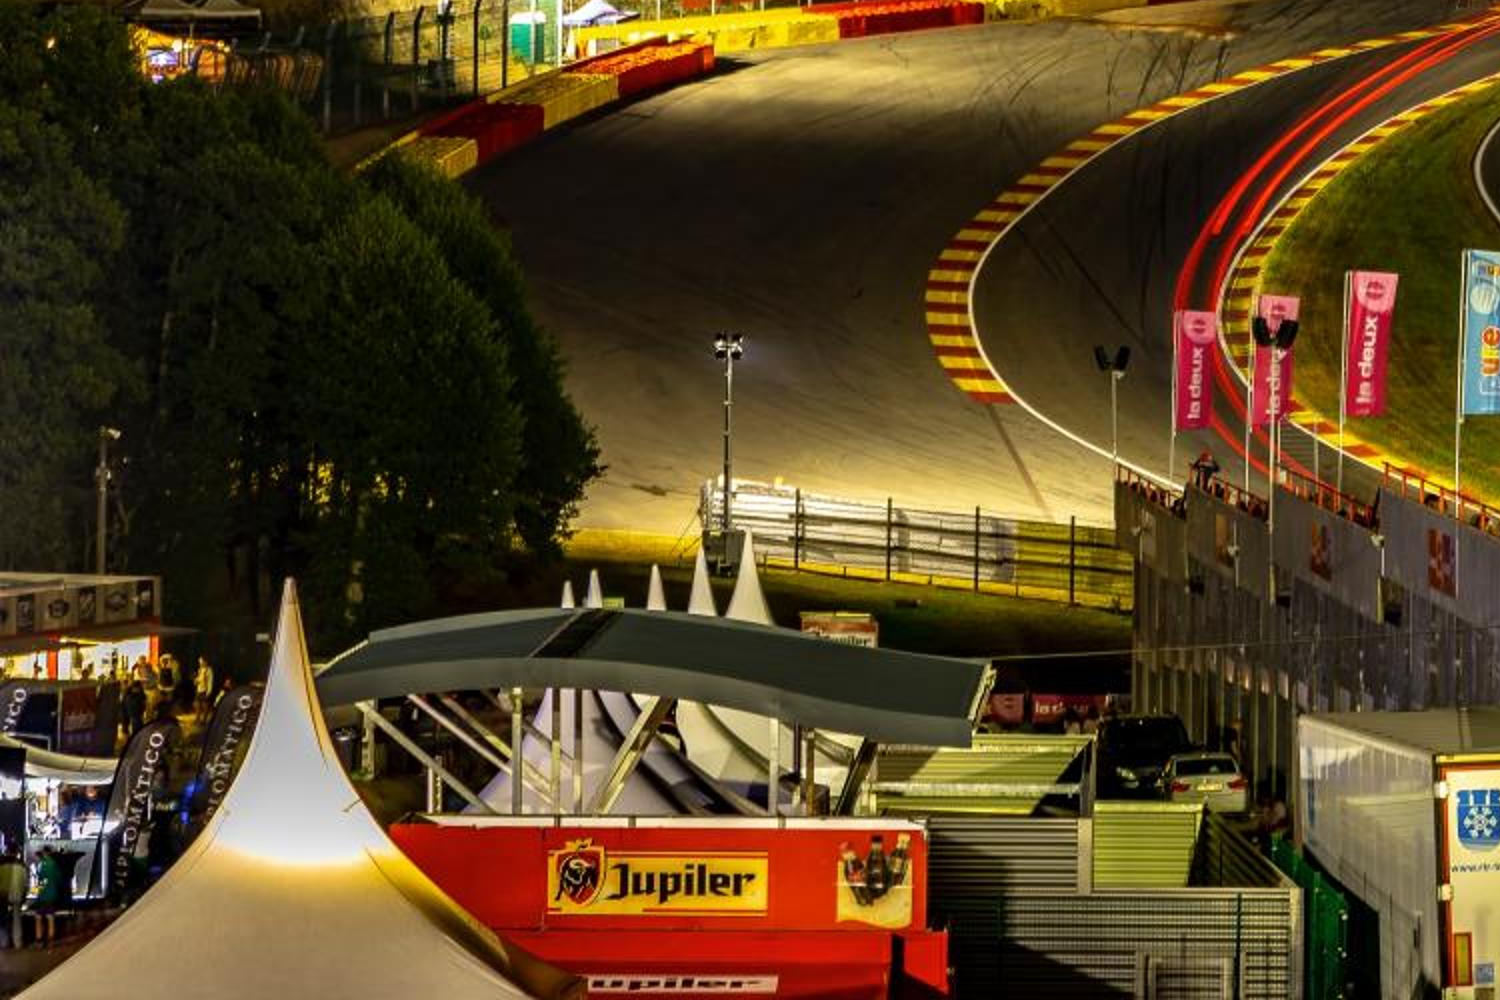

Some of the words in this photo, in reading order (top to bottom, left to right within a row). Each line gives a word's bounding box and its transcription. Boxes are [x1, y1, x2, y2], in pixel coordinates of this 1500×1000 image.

[1357, 316, 1378, 378] deux
[1189, 346, 1204, 395] deux
[1355, 381, 1373, 404] la
[607, 862, 756, 904] Jupiler
[591, 977, 763, 991] upiler
